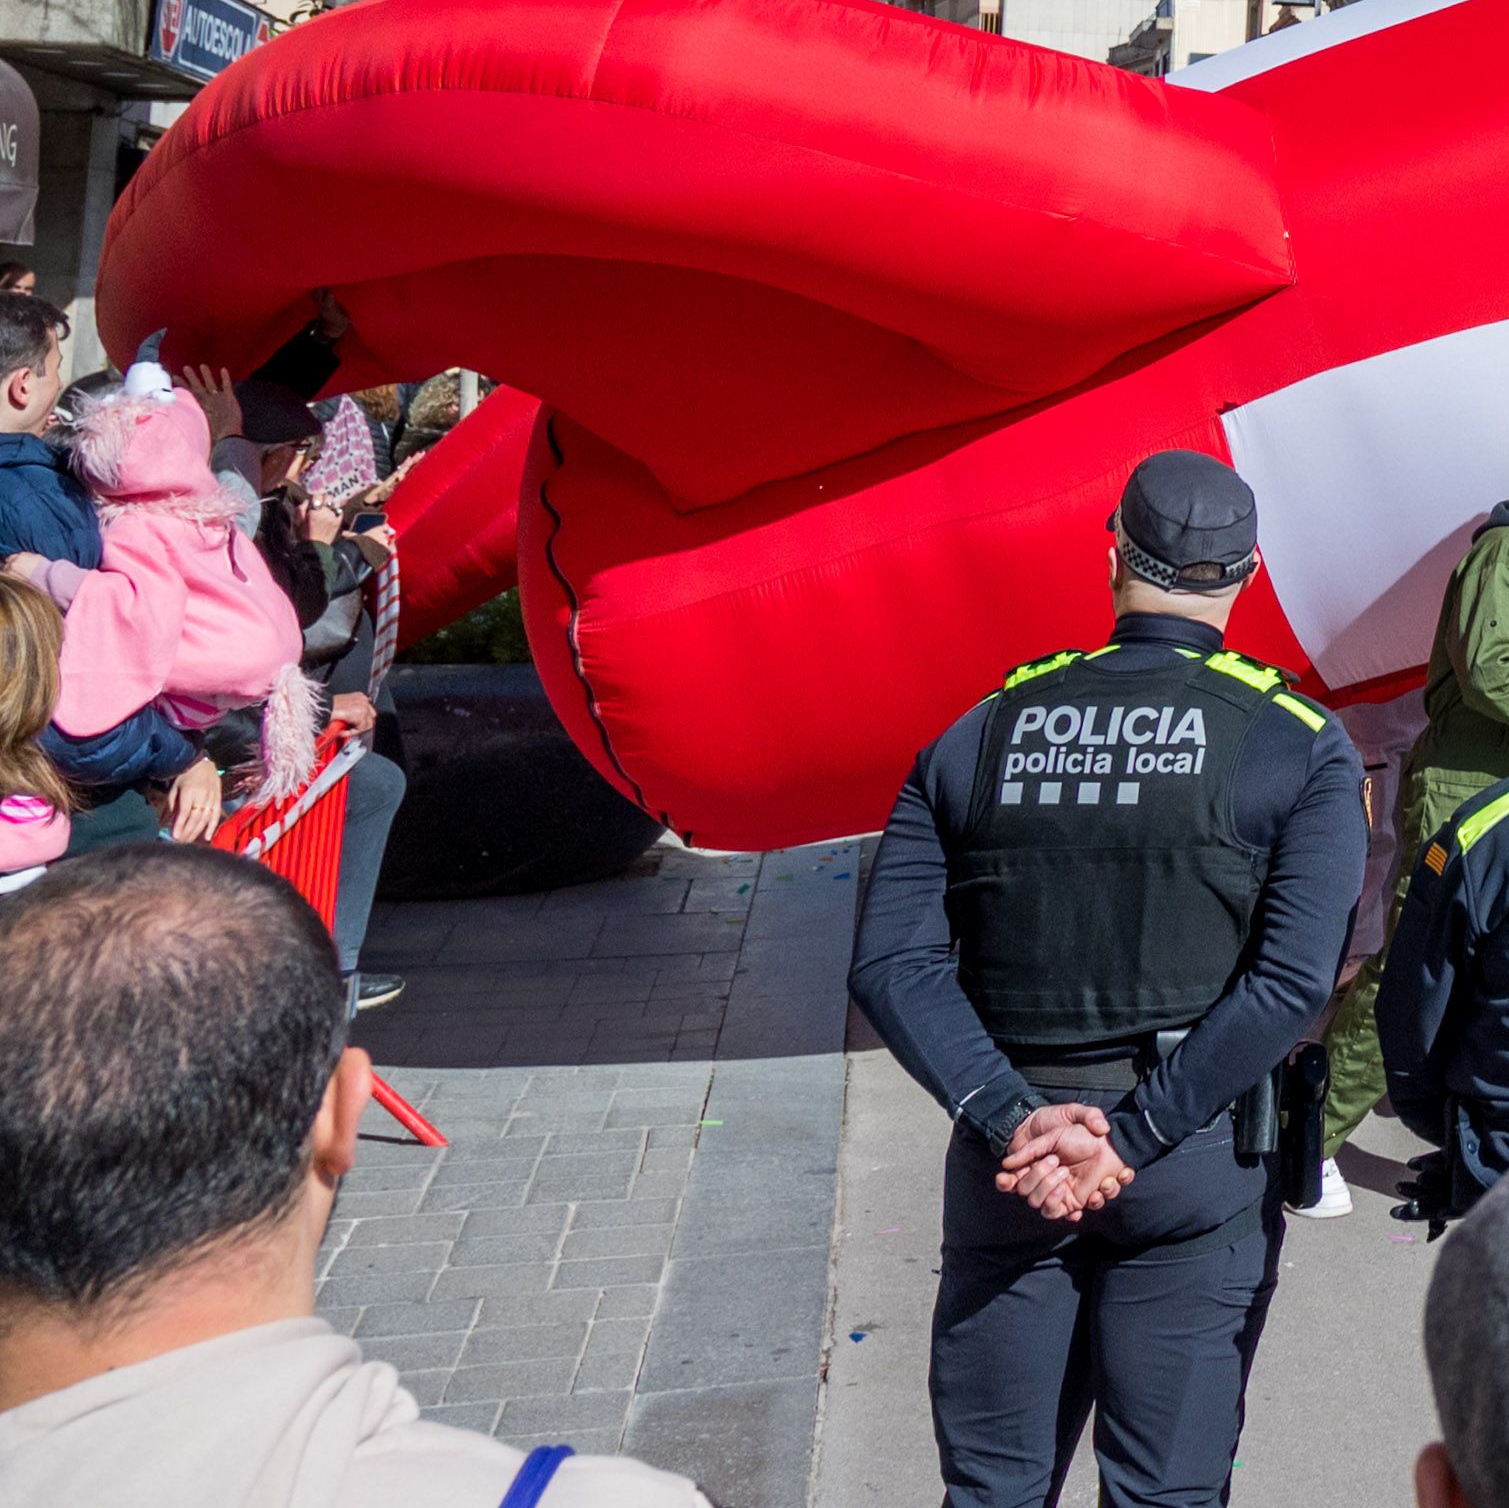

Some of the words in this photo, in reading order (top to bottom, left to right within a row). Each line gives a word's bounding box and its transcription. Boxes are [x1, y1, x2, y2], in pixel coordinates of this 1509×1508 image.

[1011, 705, 1206, 746] POLICIA
[1004, 747, 1113, 780] policia
[1126, 747, 1205, 774] local
